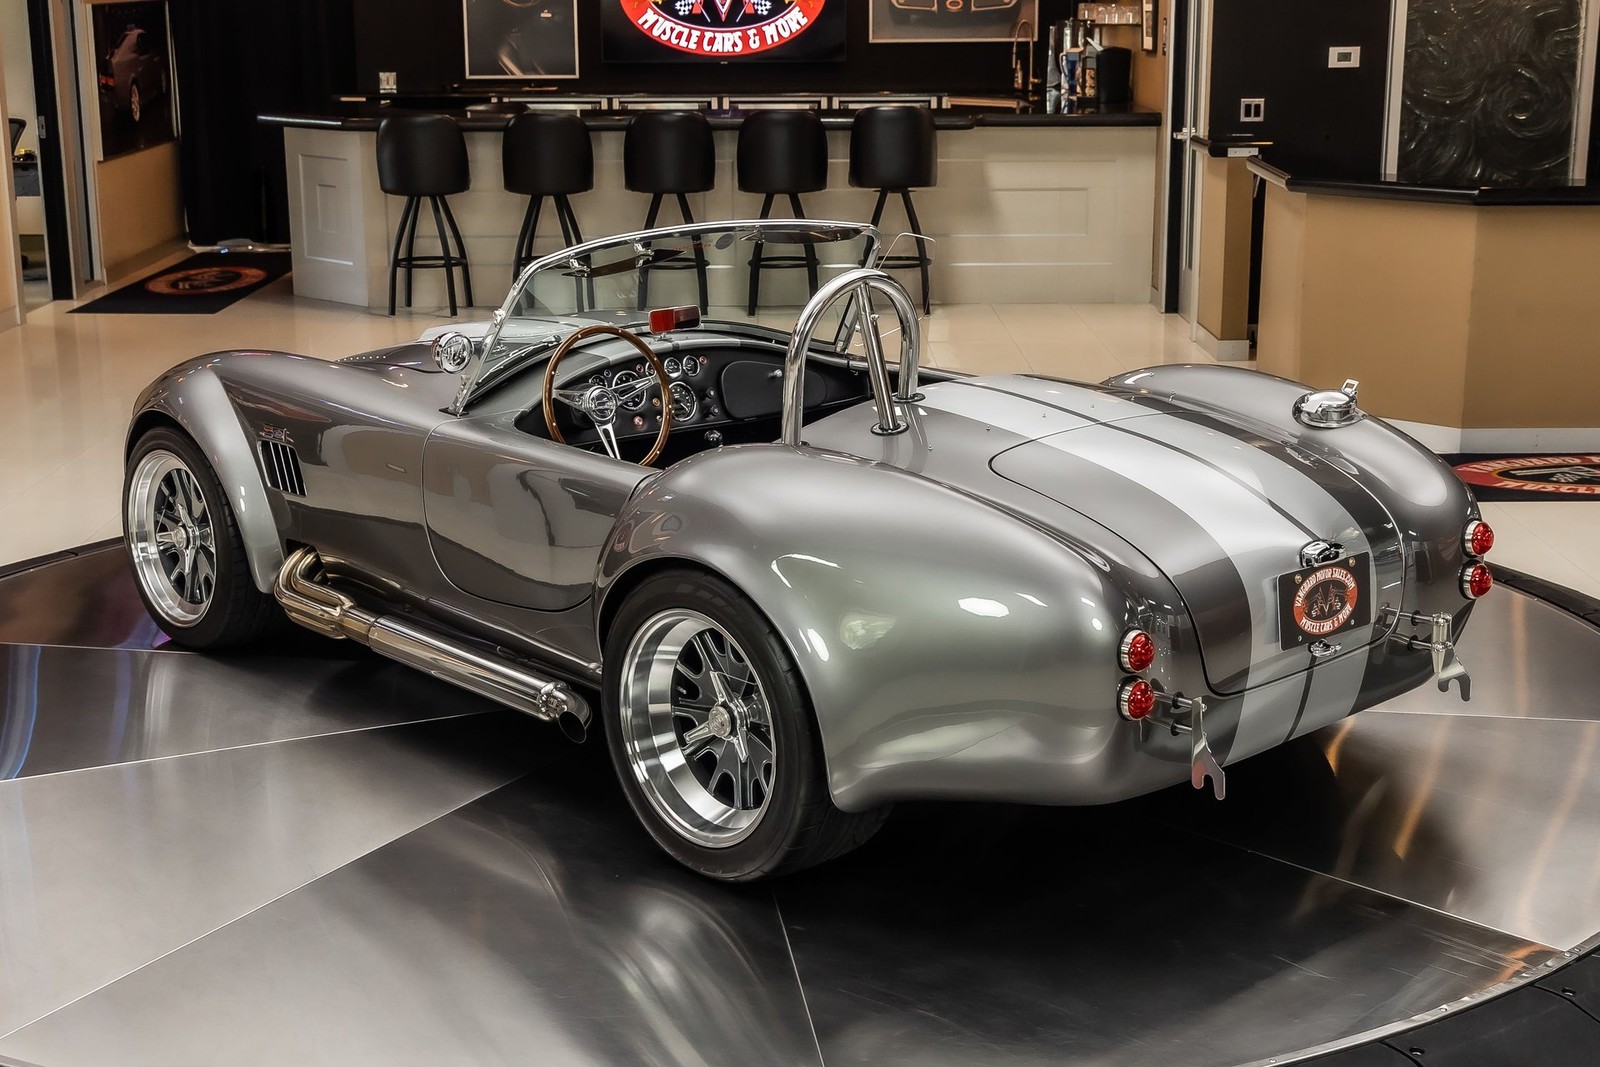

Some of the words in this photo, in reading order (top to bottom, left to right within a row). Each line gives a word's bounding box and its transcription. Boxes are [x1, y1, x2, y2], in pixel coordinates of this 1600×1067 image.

[637, 7, 700, 50] MUSCLE
[702, 31, 743, 53] CARS
[748, 28, 760, 49] &
[761, 6, 809, 46] MORE
[1295, 574, 1316, 607] VANGUARD
[1316, 569, 1332, 582] MOTOR
[1299, 616, 1320, 633] MUSCLE
[1320, 620, 1333, 632] CARS
[1339, 604, 1353, 623] MORE
